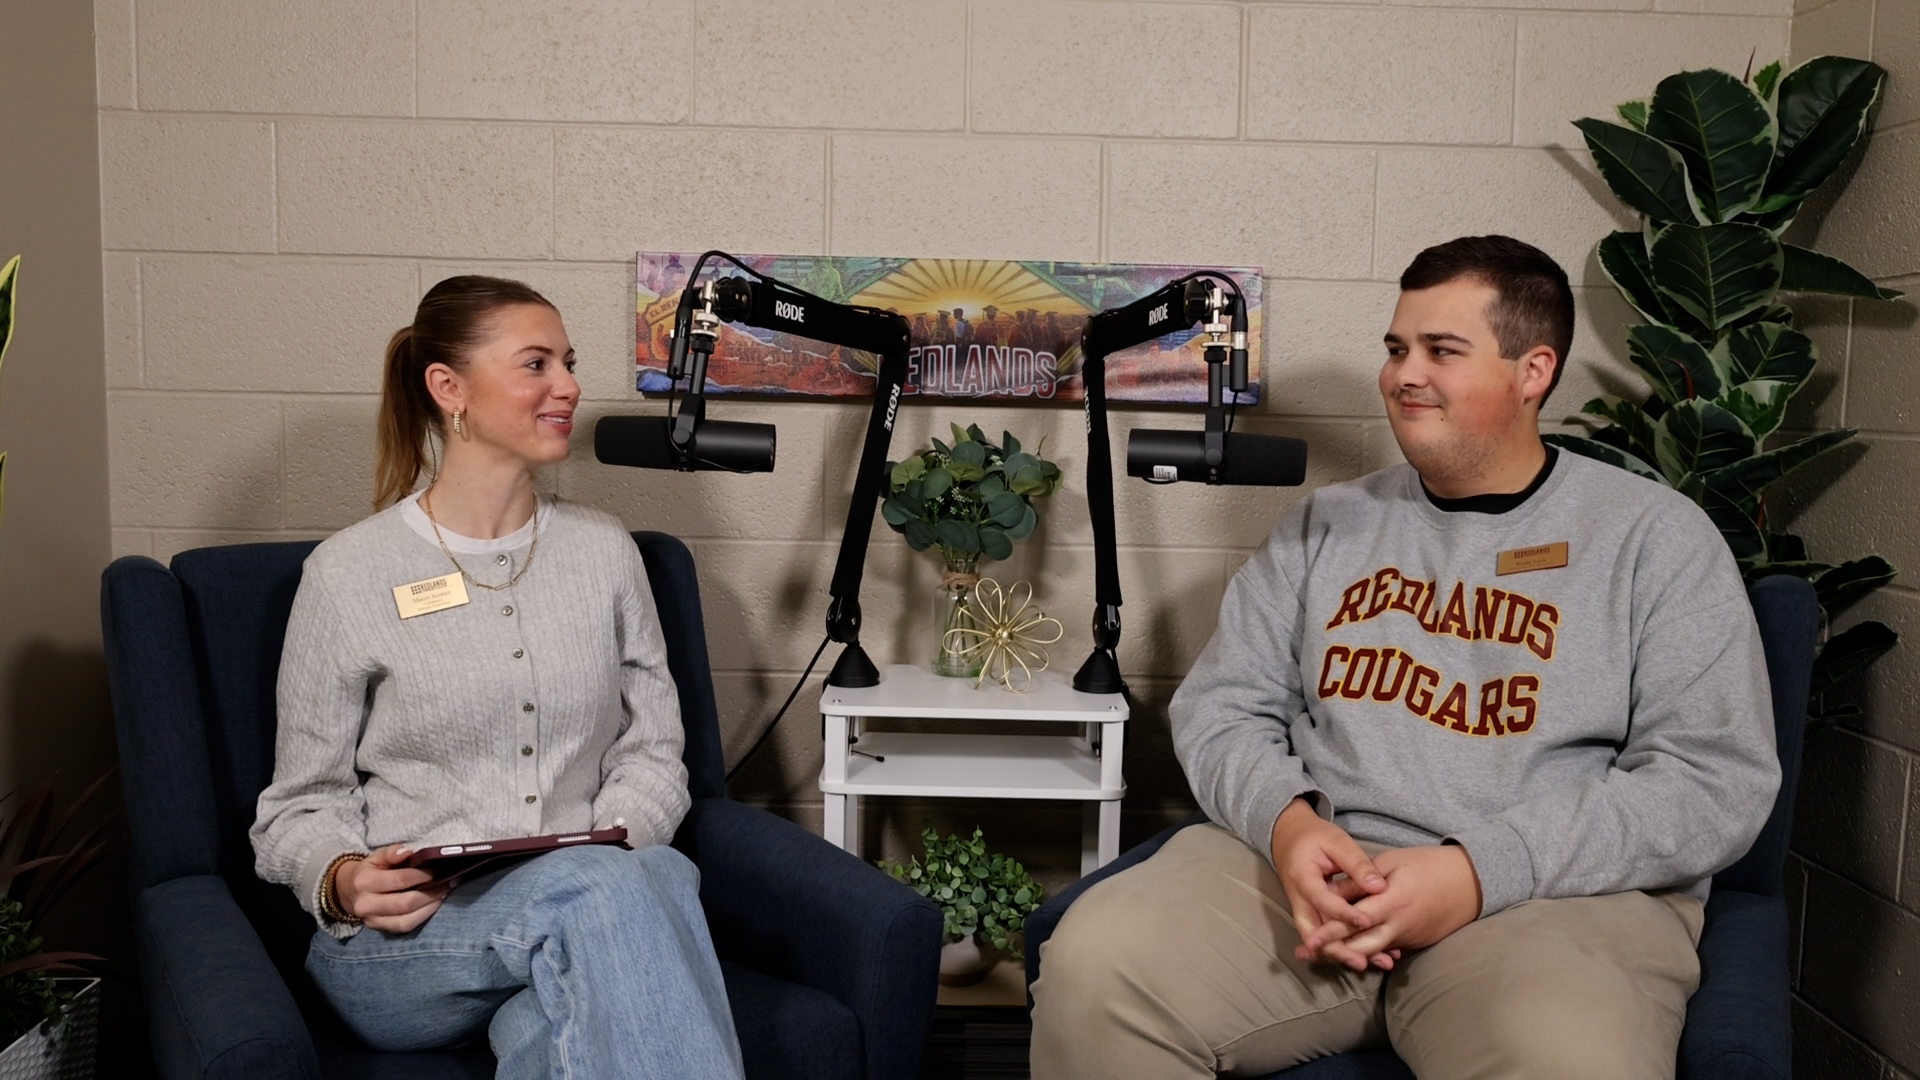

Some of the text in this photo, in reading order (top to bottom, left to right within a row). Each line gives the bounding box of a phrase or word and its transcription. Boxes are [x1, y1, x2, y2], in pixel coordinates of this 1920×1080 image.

[649, 296, 680, 319] EL REN
[775, 300, 805, 323] RØDE
[1149, 302, 1168, 326] RØDE
[877, 344, 1057, 398] EDLANDS
[884, 383, 900, 432] RØDE
[1325, 566, 1560, 662] REDLANDS
[1317, 644, 1541, 737] COUGARS
